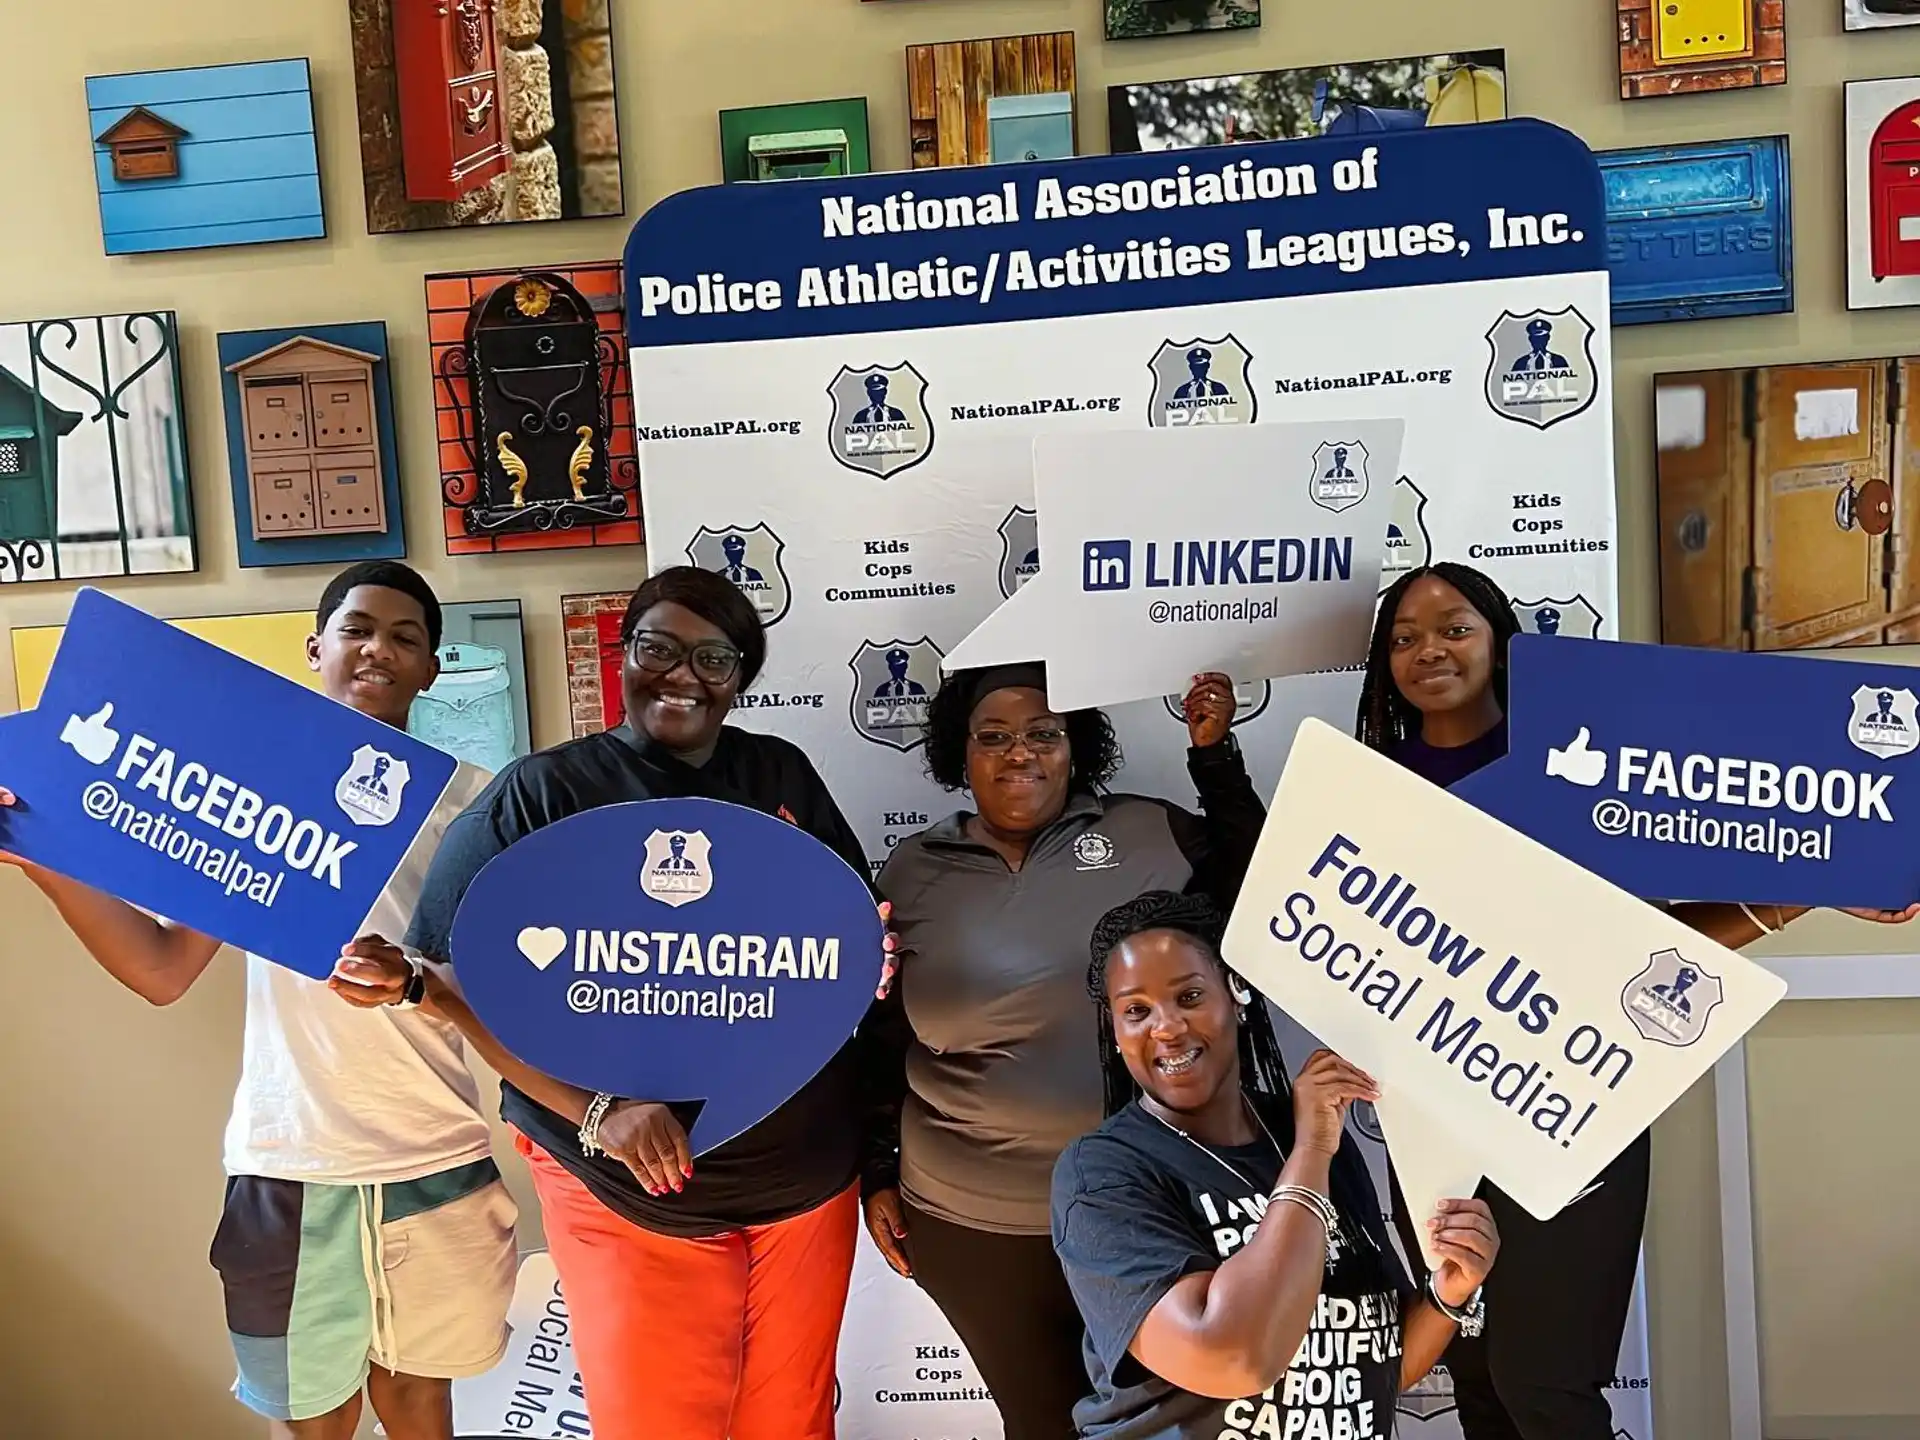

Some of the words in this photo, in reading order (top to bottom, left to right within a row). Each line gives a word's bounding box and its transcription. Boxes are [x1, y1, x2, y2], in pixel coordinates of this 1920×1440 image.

[822, 182, 1019, 239] National
[1035, 159, 1317, 220] Association
[1333, 147, 1378, 191] of
[1606, 223, 1773, 263] ETTERS
[639, 273, 782, 317] Police
[798, 237, 1230, 308] Athletic/Activities
[1246, 222, 1471, 273] Leagues,
[1488, 207, 1584, 250] Inc.
[1274, 367, 1452, 395] NationalPAL.org
[1502, 370, 1578, 382] NATIONAL
[1502, 378, 1578, 400] PAL
[950, 397, 1120, 421] NationalPAL.org
[1165, 397, 1238, 410] NATIONAL
[1166, 406, 1239, 427] PAL
[638, 419, 802, 441] NationalPAL.org
[844, 422, 915, 435] NATIONAL
[845, 431, 917, 452] PAL
[1319, 484, 1359, 497] PAL
[1512, 493, 1561, 509] Kids
[1512, 517, 1563, 534] Cops
[864, 540, 910, 556] Kids
[1468, 537, 1609, 560] Communities
[865, 561, 912, 580] Cops
[1145, 536, 1353, 588] LINKEDIN
[825, 581, 956, 603] Communities
[1149, 597, 1279, 626] @nationalpal
[734, 693, 824, 708] lPAL.org
[1859, 722, 1909, 733] NATIONAL
[1859, 728, 1909, 745] PAL
[348, 781, 390, 804] NATIONAL
[1617, 746, 1895, 823] FACEBOOK
[116, 733, 358, 890] FACEBOOK
[343, 788, 387, 818] PAL
[883, 812, 928, 826] Kids
[1592, 798, 1832, 863] @nationalpal
[82, 780, 285, 908] @nationalpal
[651, 876, 701, 890] PAL
[574, 928, 840, 980] INSTAGRAM
[1307, 832, 1486, 979] Follow
[1484, 954, 1560, 1036] Us
[1563, 1023, 1635, 1091] on
[566, 979, 775, 1025] @nationalpal
[1640, 986, 1692, 1024] NATIONAL
[1268, 891, 1424, 1023] Social
[1415, 996, 1599, 1150] Media!
[1631, 992, 1684, 1038] PAL
[1199, 1191, 1221, 1226] I
[915, 1346, 960, 1360] Kids
[915, 1367, 963, 1384] Cops
[875, 1387, 994, 1404] Communitie
